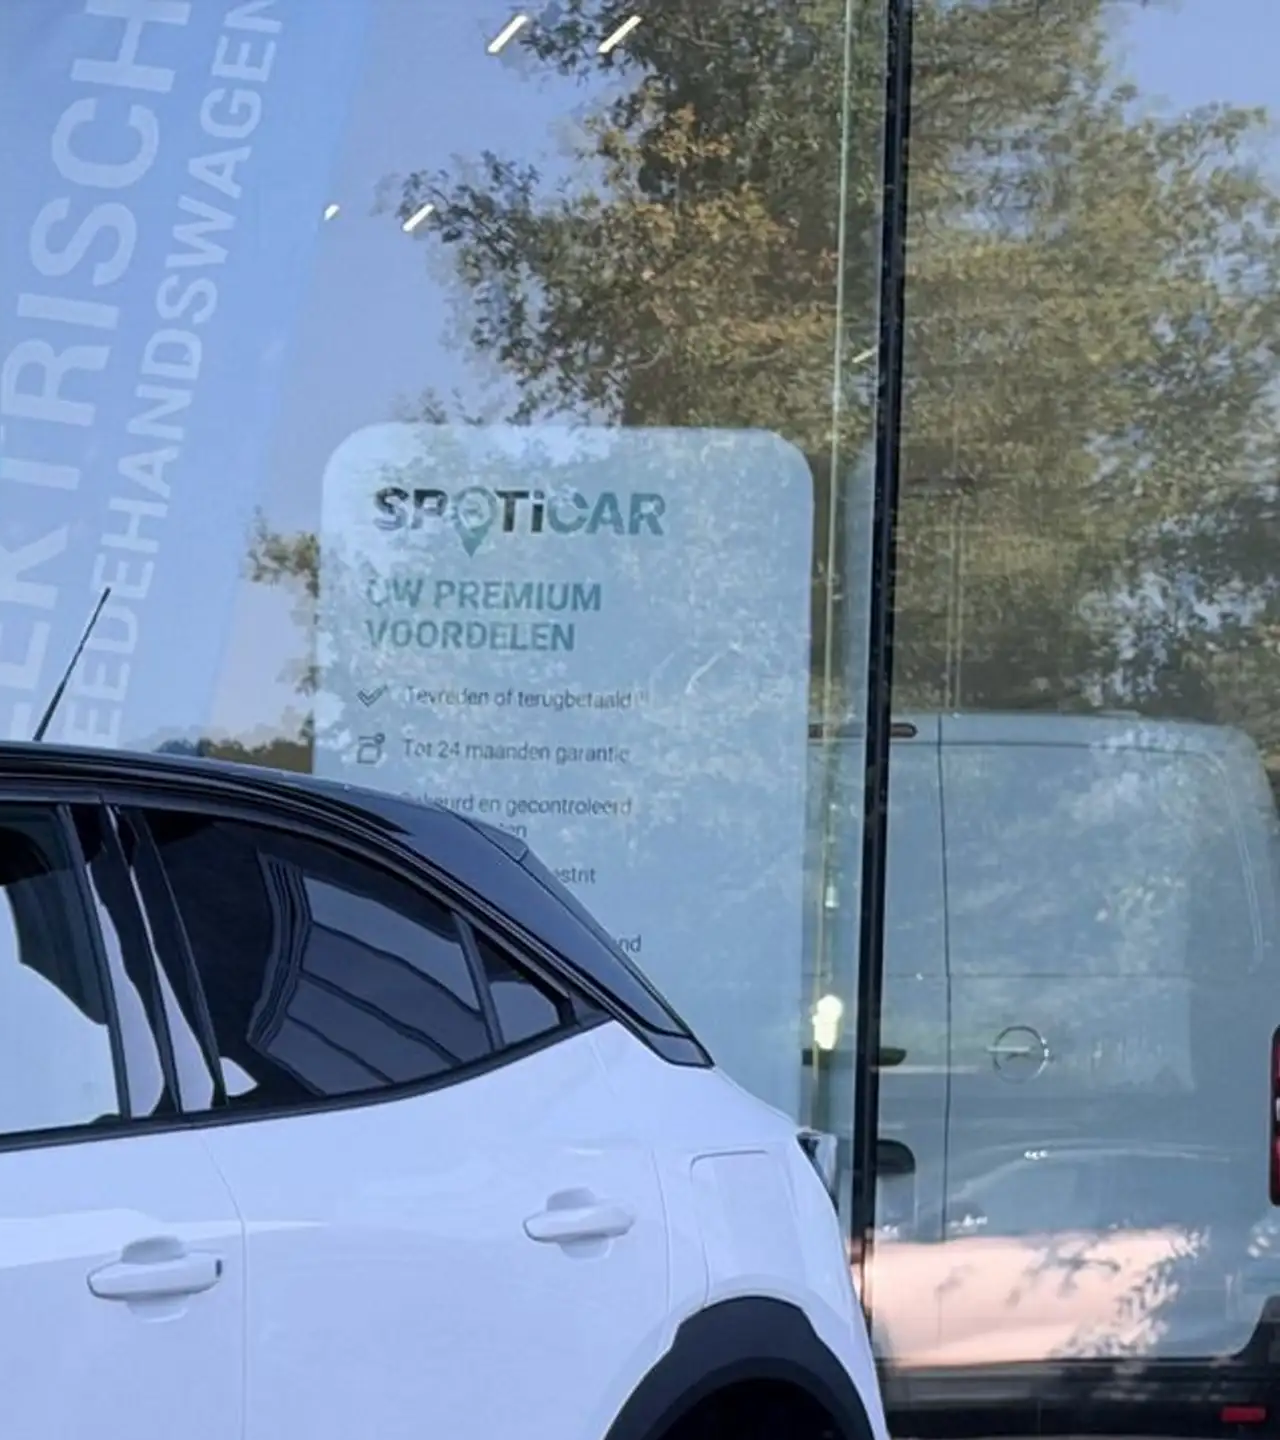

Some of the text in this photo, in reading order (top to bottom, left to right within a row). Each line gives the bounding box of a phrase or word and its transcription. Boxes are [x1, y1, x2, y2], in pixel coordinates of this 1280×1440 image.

[366, 578, 602, 612] UW PREMIUM
[365, 619, 575, 651] VOORDELEN
[405, 685, 490, 706] Tevreden
[494, 686, 513, 707] of
[518, 690, 633, 712] terugbetaald
[402, 738, 631, 765] Tot 24 maanden garantie
[479, 799, 499, 814] en
[506, 797, 632, 818] gecontroleerd
